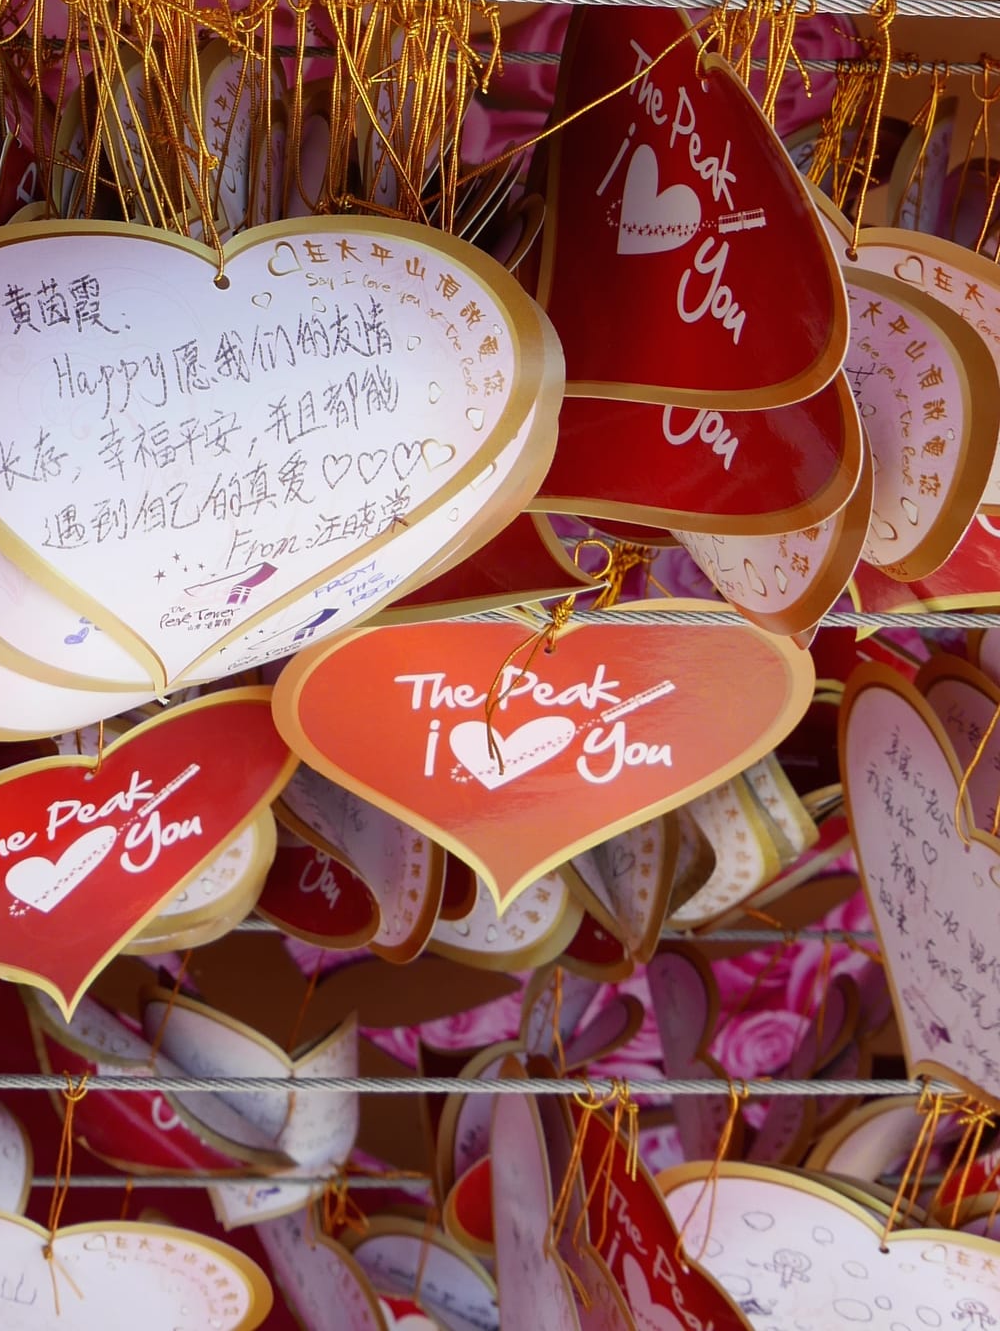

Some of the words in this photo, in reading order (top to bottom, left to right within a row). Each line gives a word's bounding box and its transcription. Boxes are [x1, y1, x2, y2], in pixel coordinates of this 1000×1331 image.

[630, 39, 668, 125] The
[669, 86, 737, 211] Peak
[596, 122, 636, 197] i
[677, 236, 746, 345] You
[305, 272, 335, 290] Say
[340, 270, 356, 285] I
[362, 274, 392, 293] love
[159, 612, 192, 629] Peak
[193, 608, 240, 621] Tower
[394, 672, 488, 710] The
[499, 664, 622, 710] Peak
[424, 719, 440, 777] i
[576, 721, 673, 784] You
[46, 770, 154, 841] Peak
[119, 810, 203, 874] You
